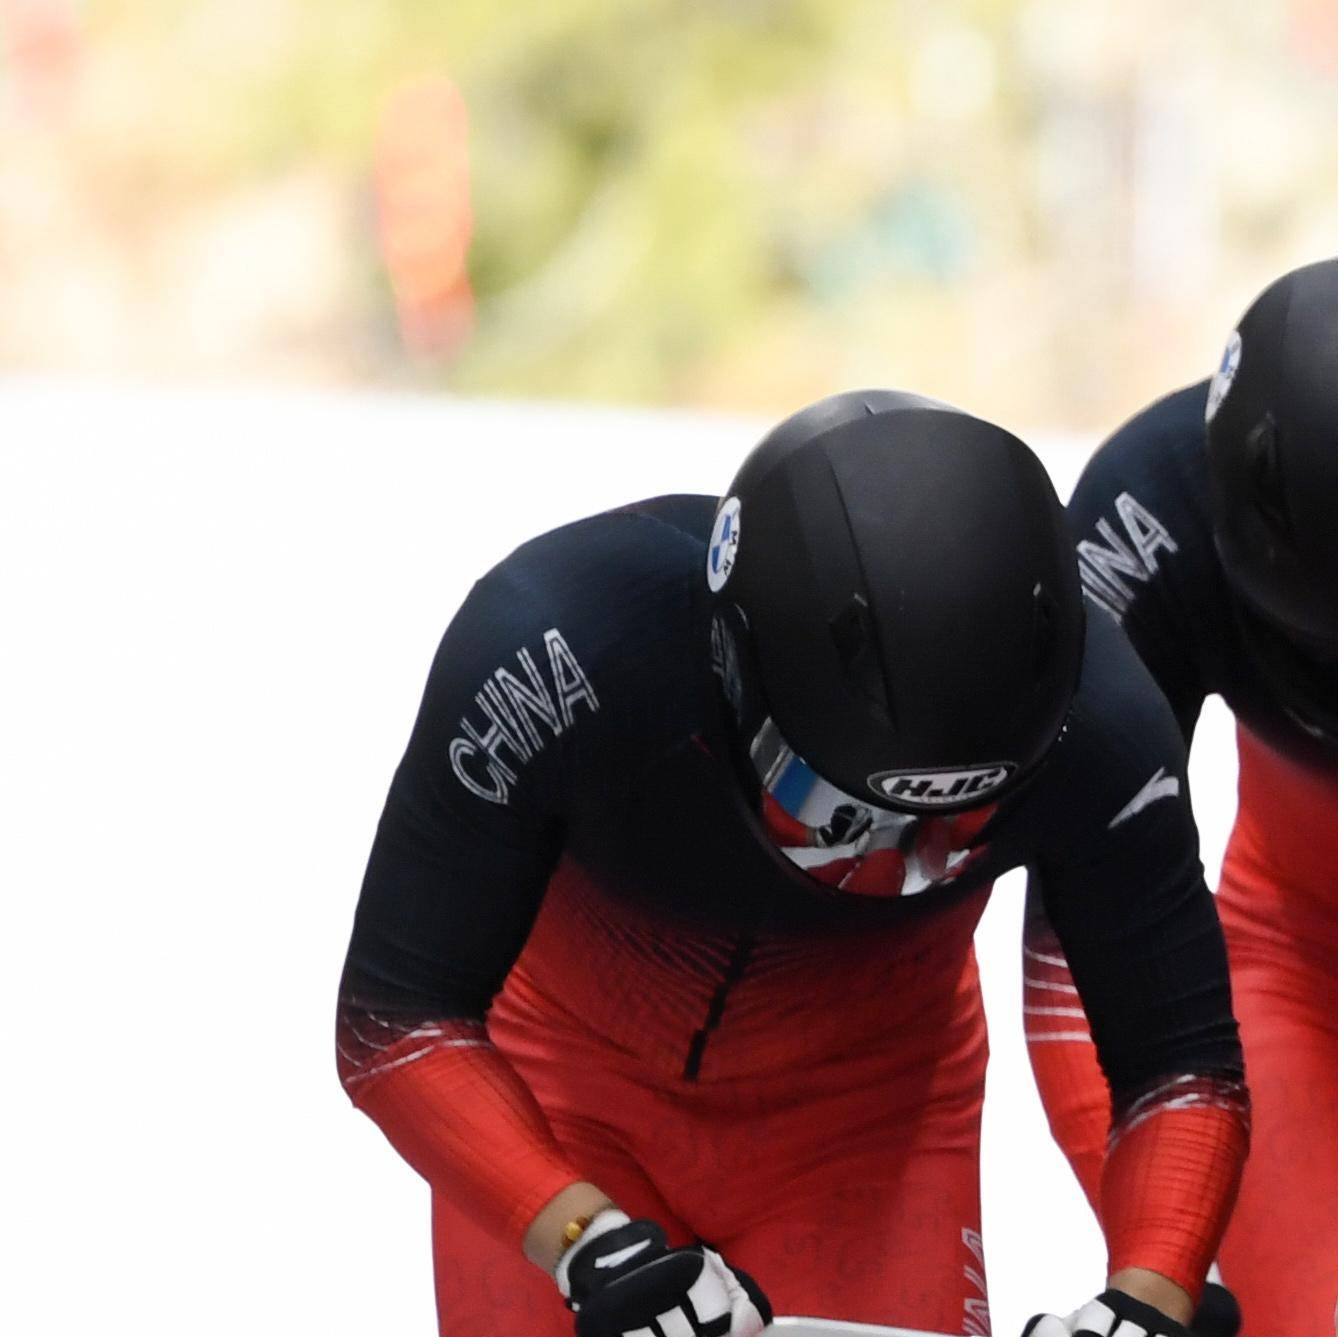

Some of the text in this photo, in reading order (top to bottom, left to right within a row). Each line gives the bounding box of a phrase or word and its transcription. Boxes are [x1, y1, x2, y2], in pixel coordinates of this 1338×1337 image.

[1076, 491, 1178, 626] INA
[449, 627, 600, 805] CHINA
[889, 767, 1002, 797] HJC
